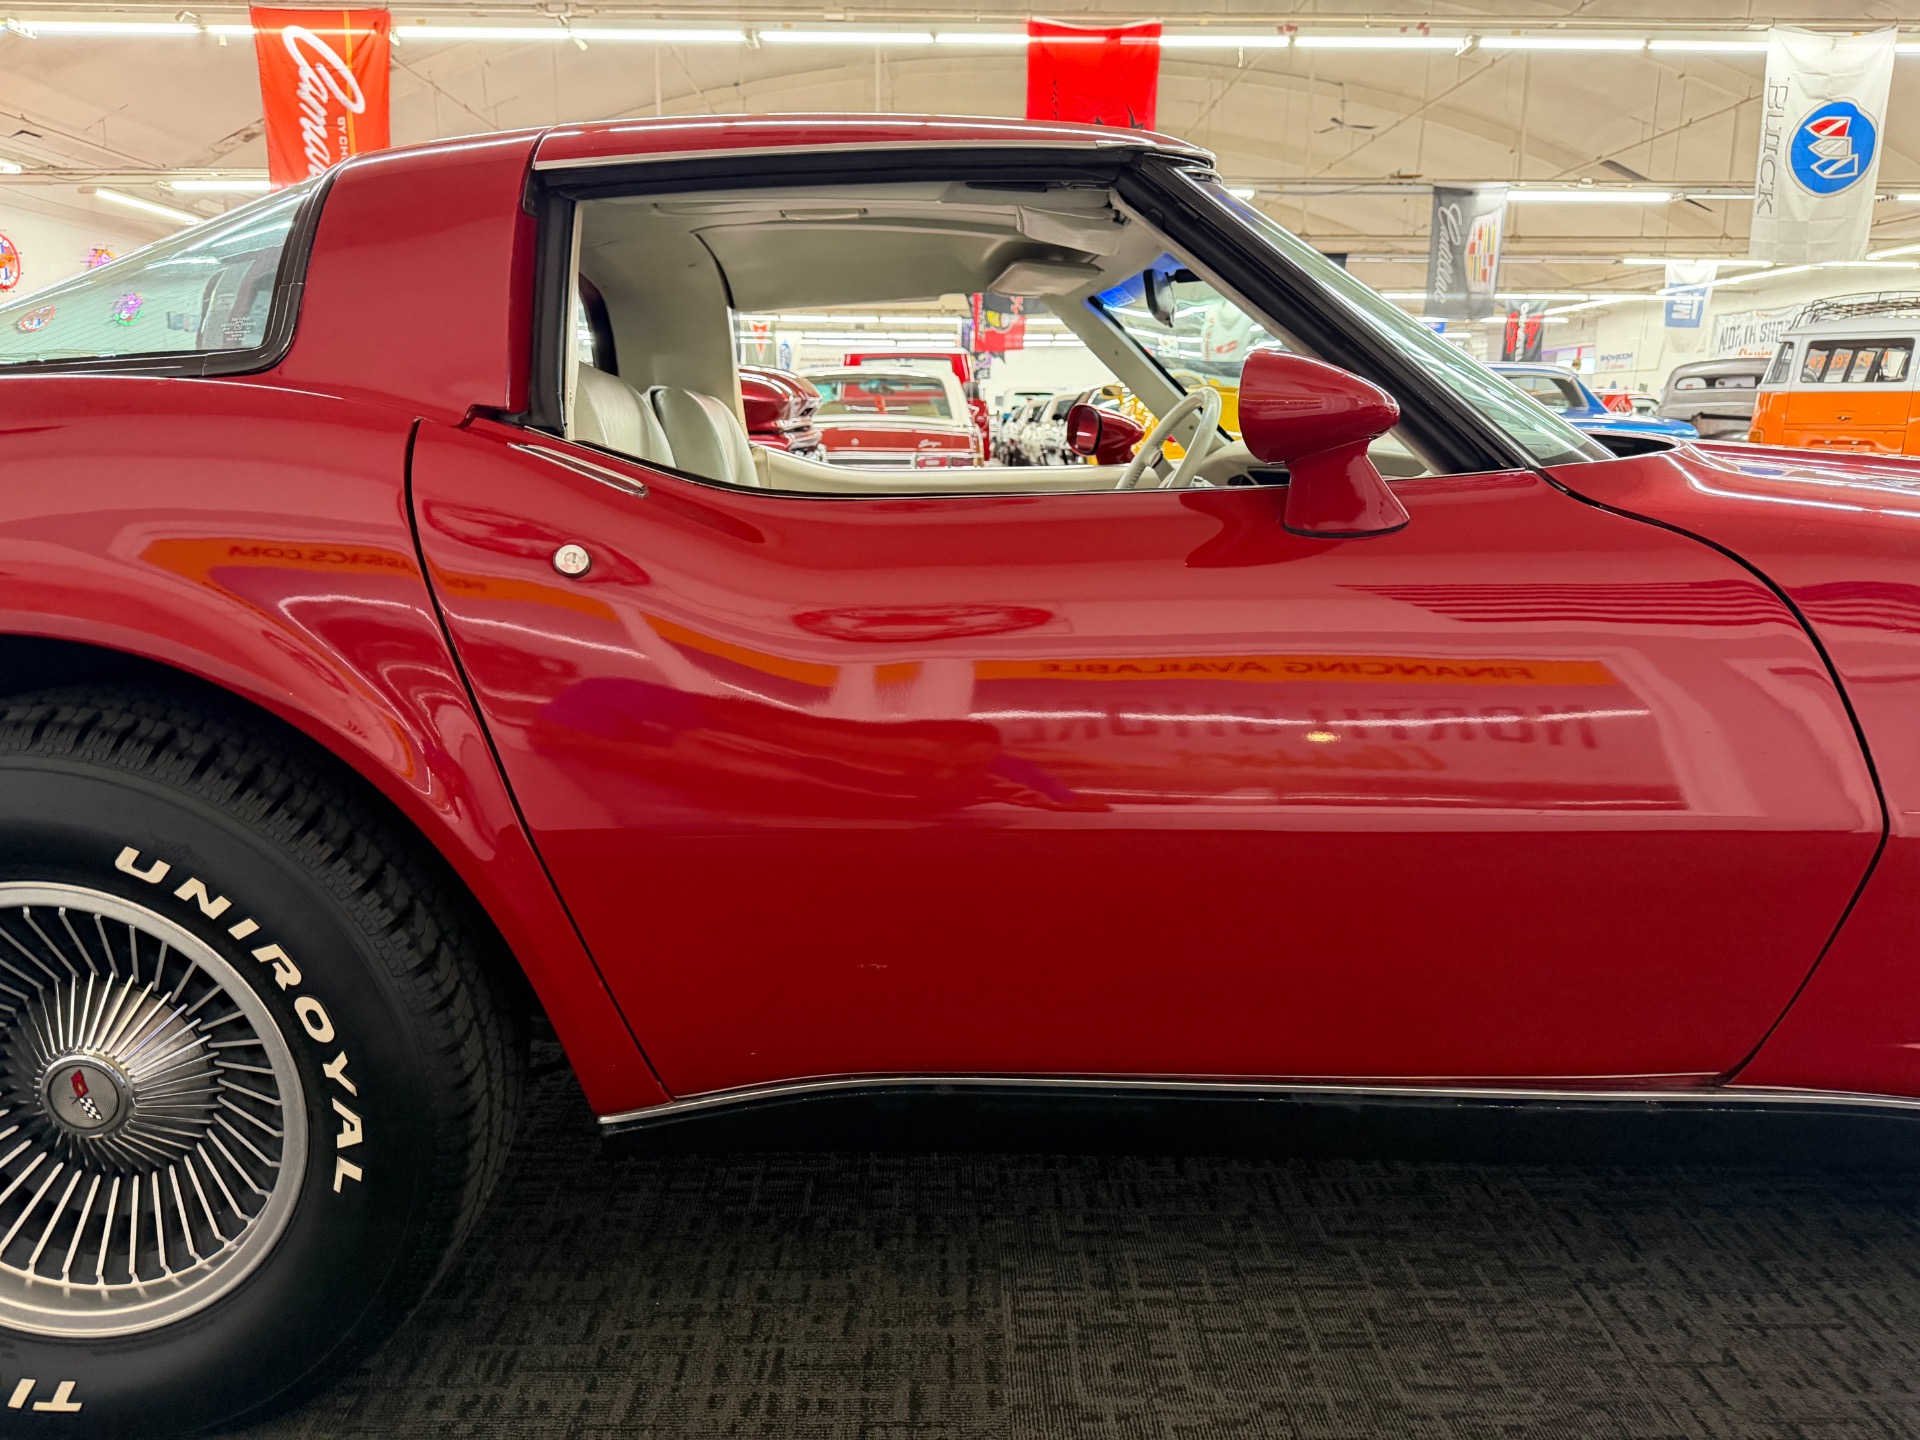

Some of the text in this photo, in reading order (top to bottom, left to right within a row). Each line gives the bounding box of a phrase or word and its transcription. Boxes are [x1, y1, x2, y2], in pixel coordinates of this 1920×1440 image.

[336, 116, 347, 134] BY
[1757, 77, 1790, 215] BUICK
[1434, 203, 1462, 304] Cadillac
[115, 846, 363, 1194] UNIROYAL
[8, 1379, 83, 1412] TI
